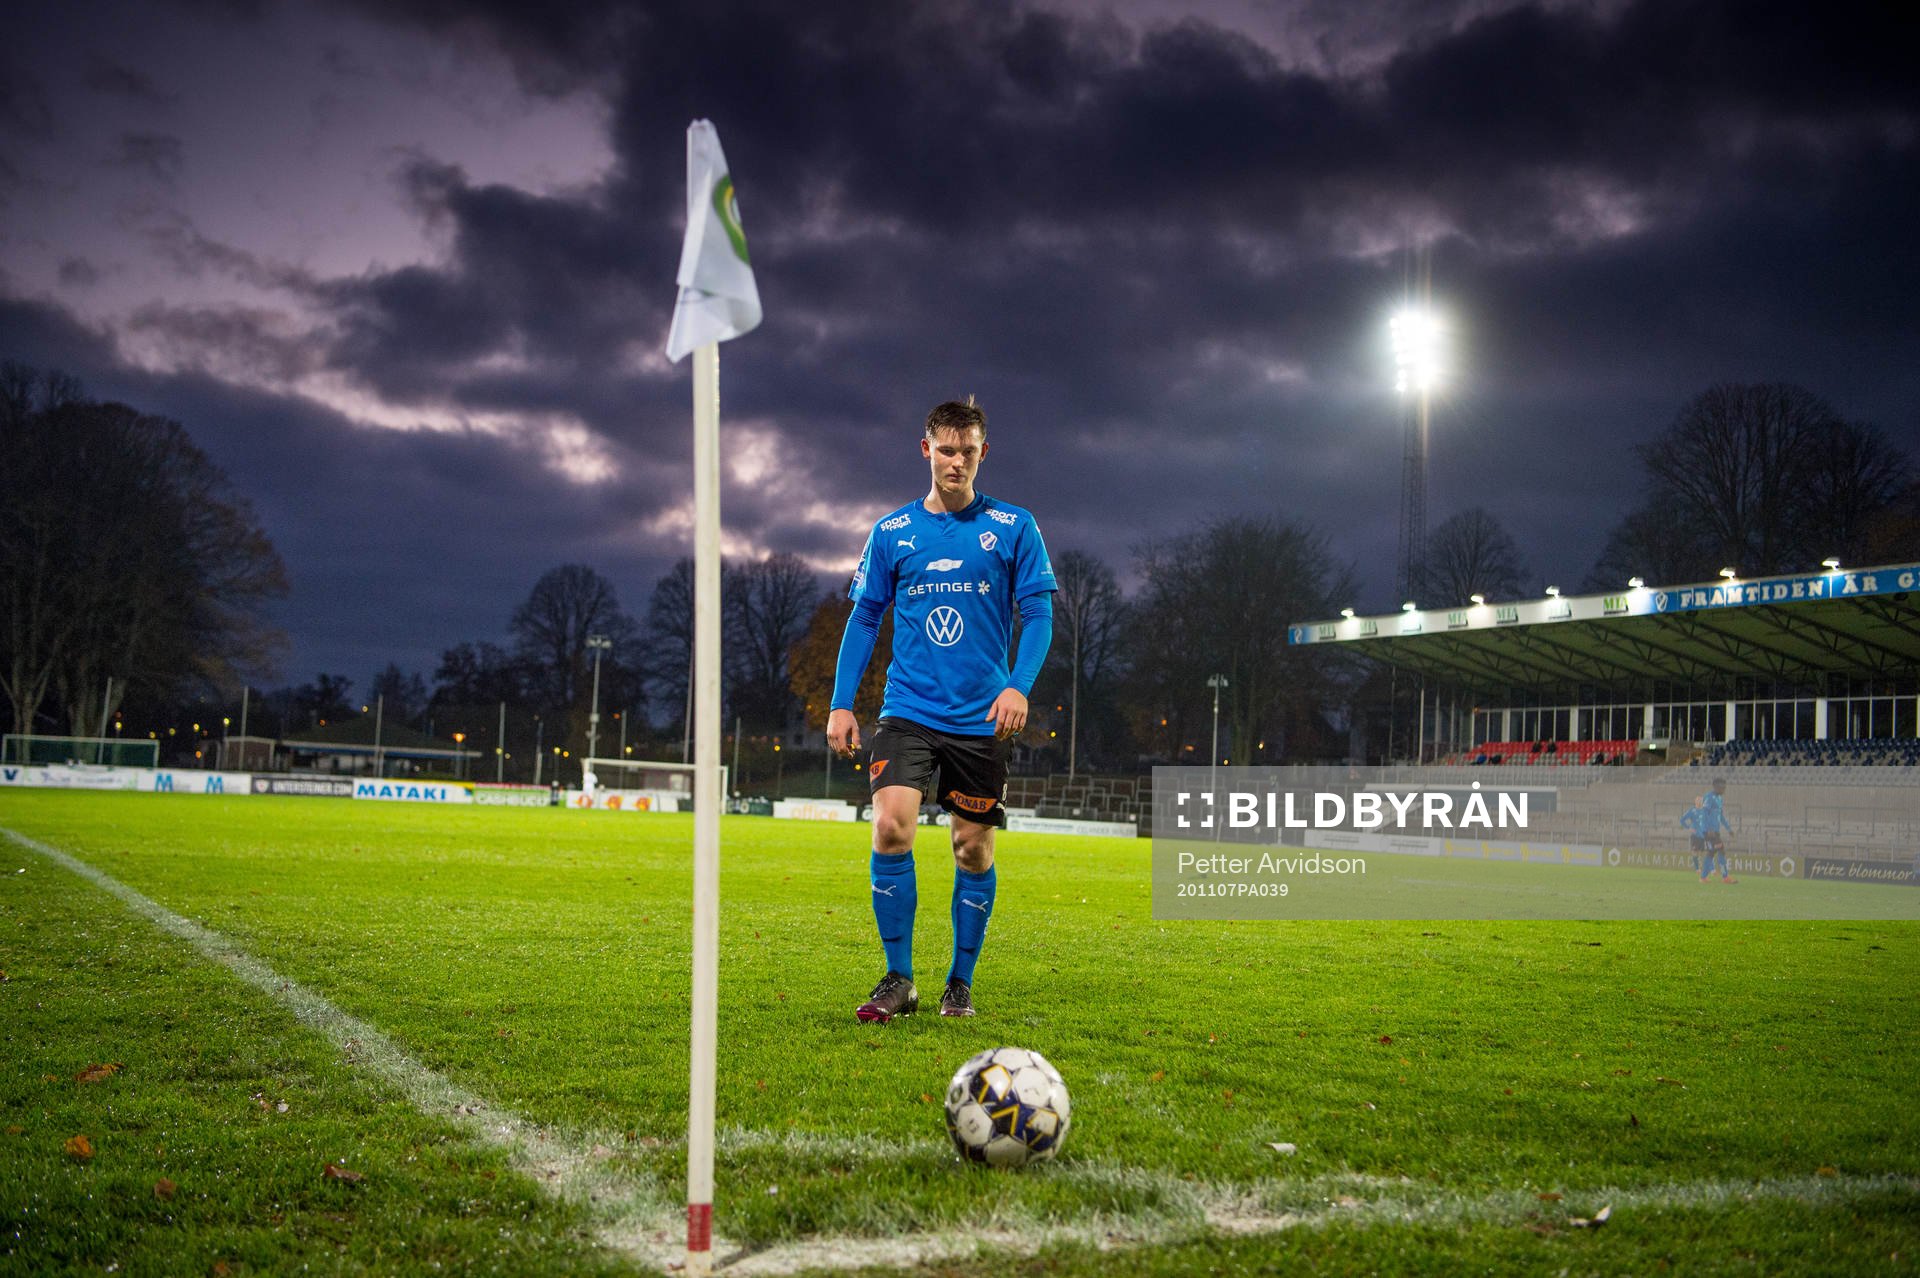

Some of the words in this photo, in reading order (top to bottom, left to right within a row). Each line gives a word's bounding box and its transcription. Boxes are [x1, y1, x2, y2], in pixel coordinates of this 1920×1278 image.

[880, 513, 910, 531] sport
[985, 508, 1018, 521] sport
[907, 582, 973, 596] GETINGE
[1680, 580, 1824, 608] FRAMTIDEN
[1842, 572, 1878, 594] ÄR
[357, 784, 447, 800] MATAKI
[1810, 861, 1844, 879] fritz
